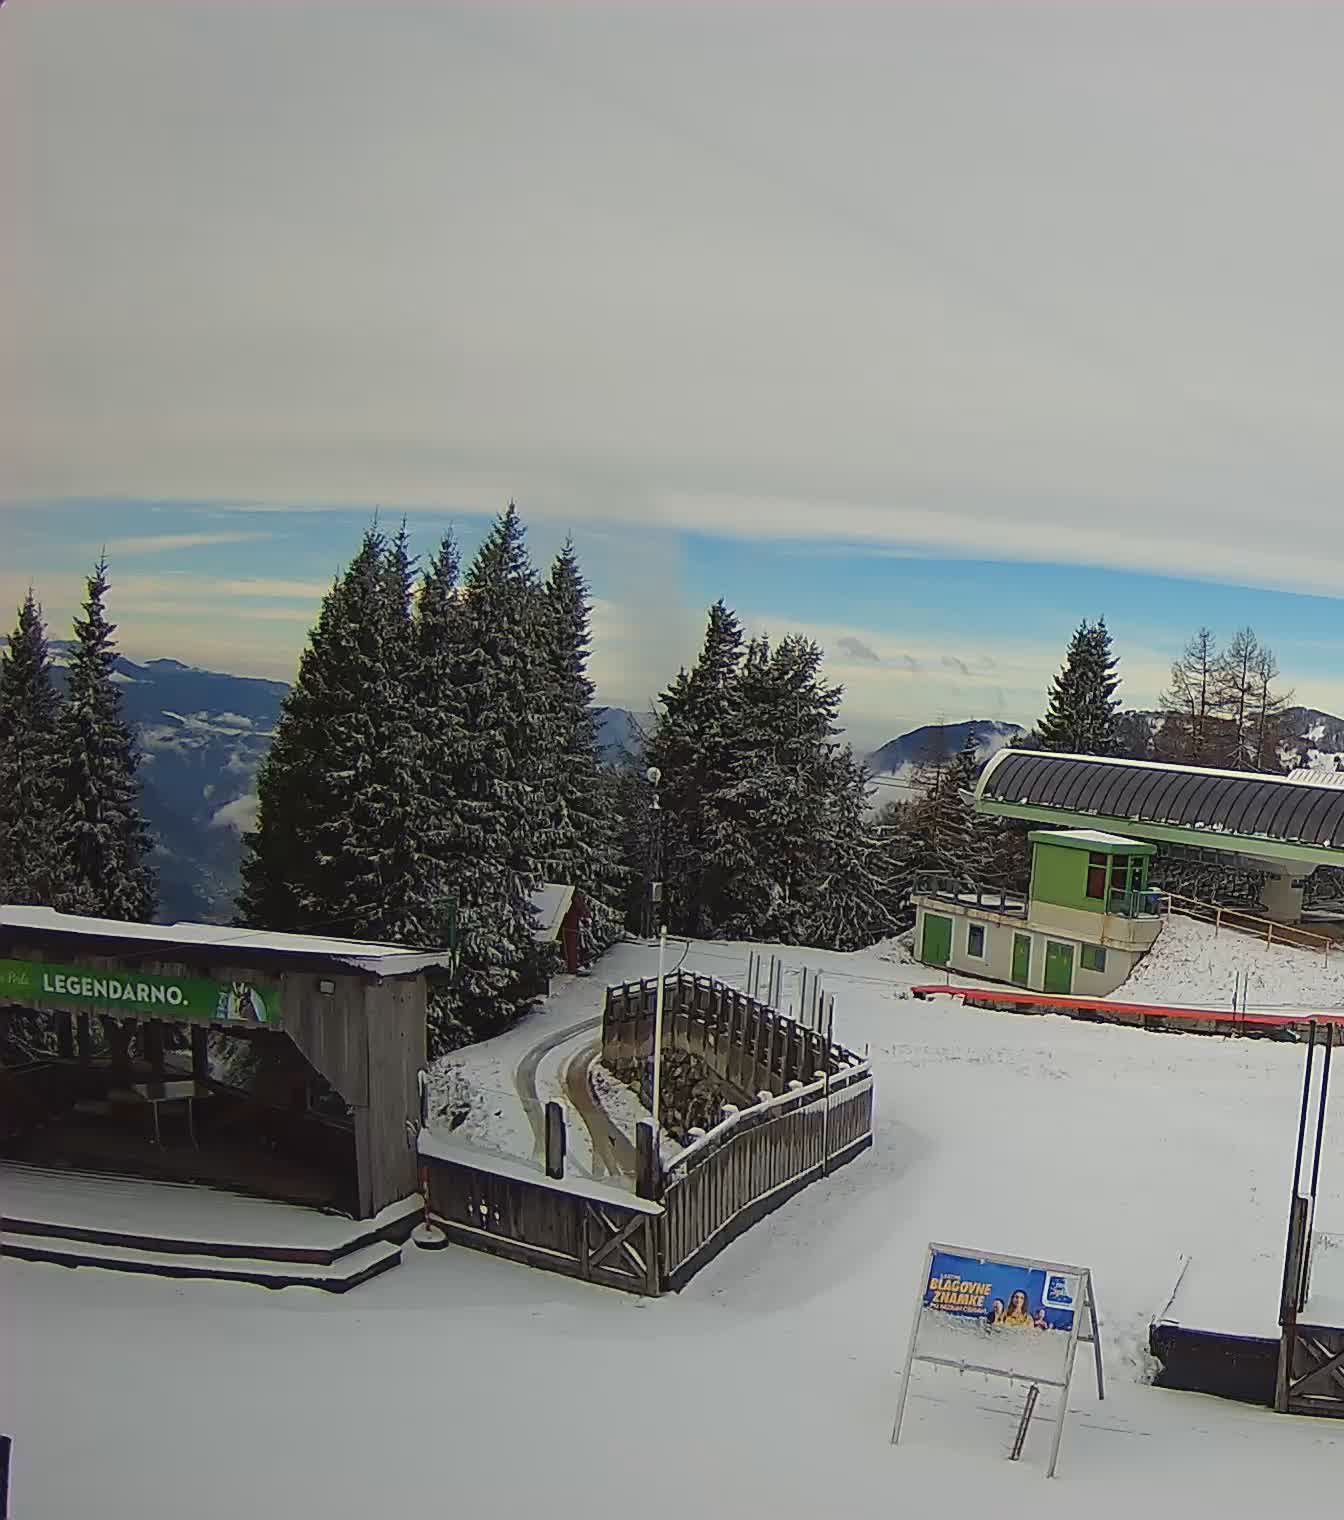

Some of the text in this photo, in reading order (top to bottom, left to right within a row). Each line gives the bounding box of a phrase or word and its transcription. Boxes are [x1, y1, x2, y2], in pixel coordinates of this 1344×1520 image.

[43, 973, 190, 1006] LEGENDARNO.
[929, 1277, 993, 1296] BLAGOVNE
[932, 1291, 985, 1307] ZNAMKE
